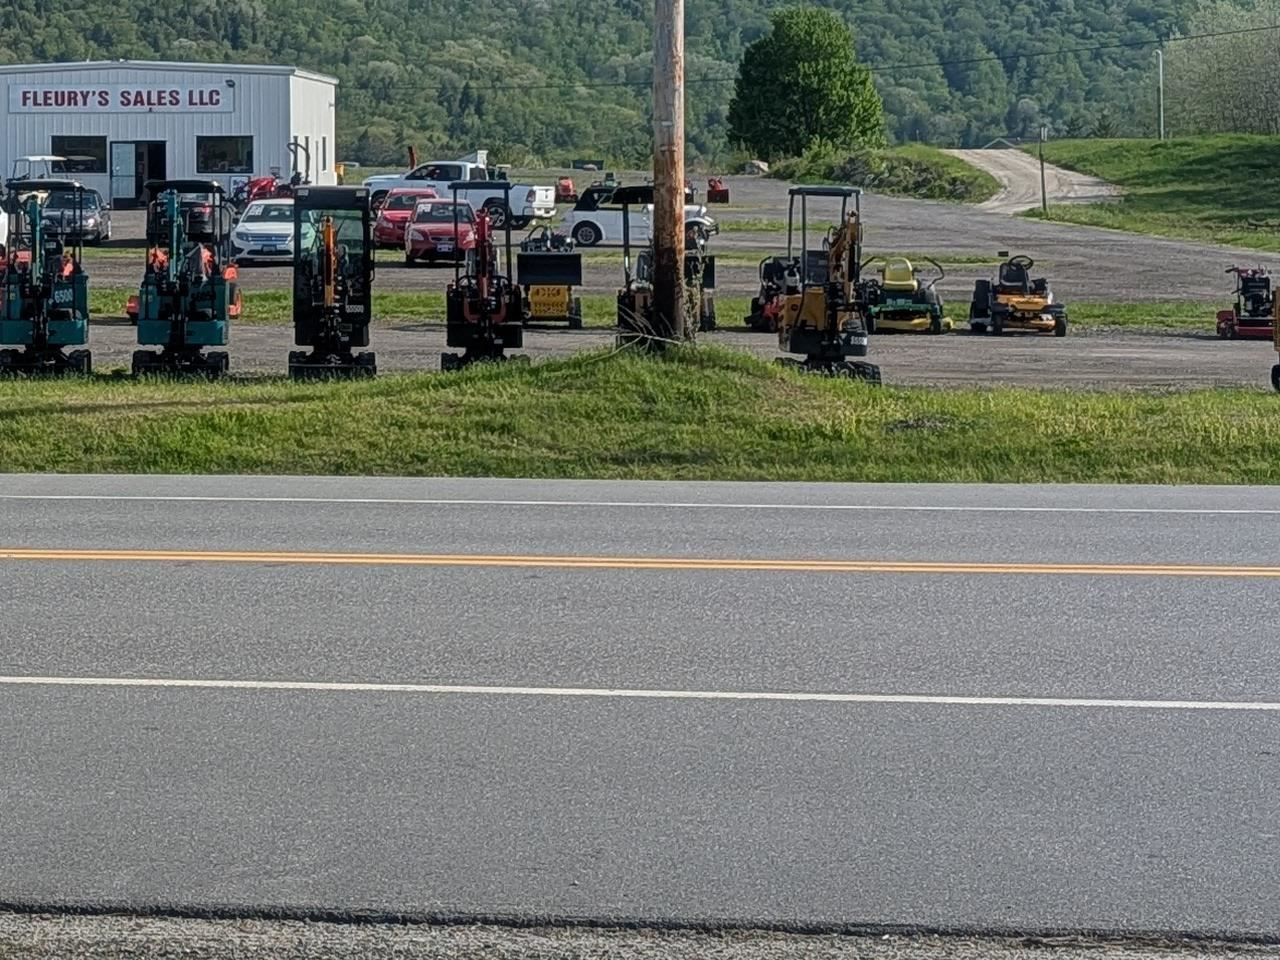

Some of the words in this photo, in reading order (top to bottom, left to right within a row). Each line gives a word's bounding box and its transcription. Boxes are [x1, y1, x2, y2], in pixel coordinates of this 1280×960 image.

[21, 90, 110, 108] FLEURY'S
[119, 89, 181, 107] SALES
[188, 89, 221, 107] LLC
